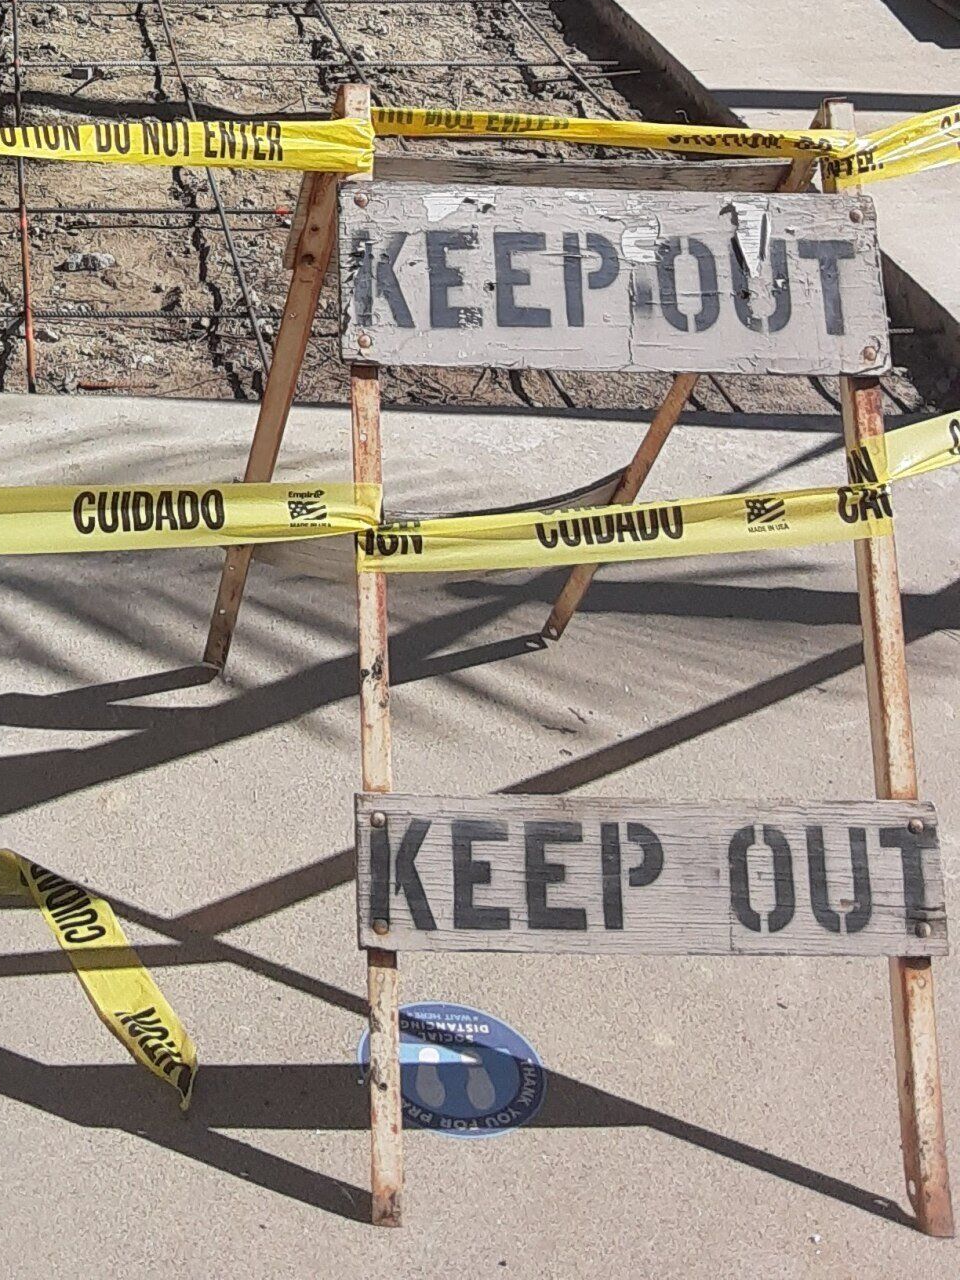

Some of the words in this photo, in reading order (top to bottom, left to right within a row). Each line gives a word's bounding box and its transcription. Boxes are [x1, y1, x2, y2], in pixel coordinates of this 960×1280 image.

[95, 123, 130, 155] DO
[142, 121, 190, 158] NOT
[203, 121, 285, 162] ENTER
[352, 230, 620, 328] KEEP
[656, 235, 856, 336] OUT
[73, 489, 225, 535] CUIDADO
[535, 505, 684, 549] CUIDADO
[776, 523, 790, 531] USA
[369, 819, 665, 931] KEEP
[728, 822, 942, 934] OUT
[413, 1012, 443, 1021] HERE
[444, 1014, 474, 1022] WAIT
[400, 1021, 490, 1034] DISTANCING
[420, 1032, 474, 1043] SOCIAL
[440, 1117, 479, 1129] FOR
[485, 1106, 522, 1128] YOU
